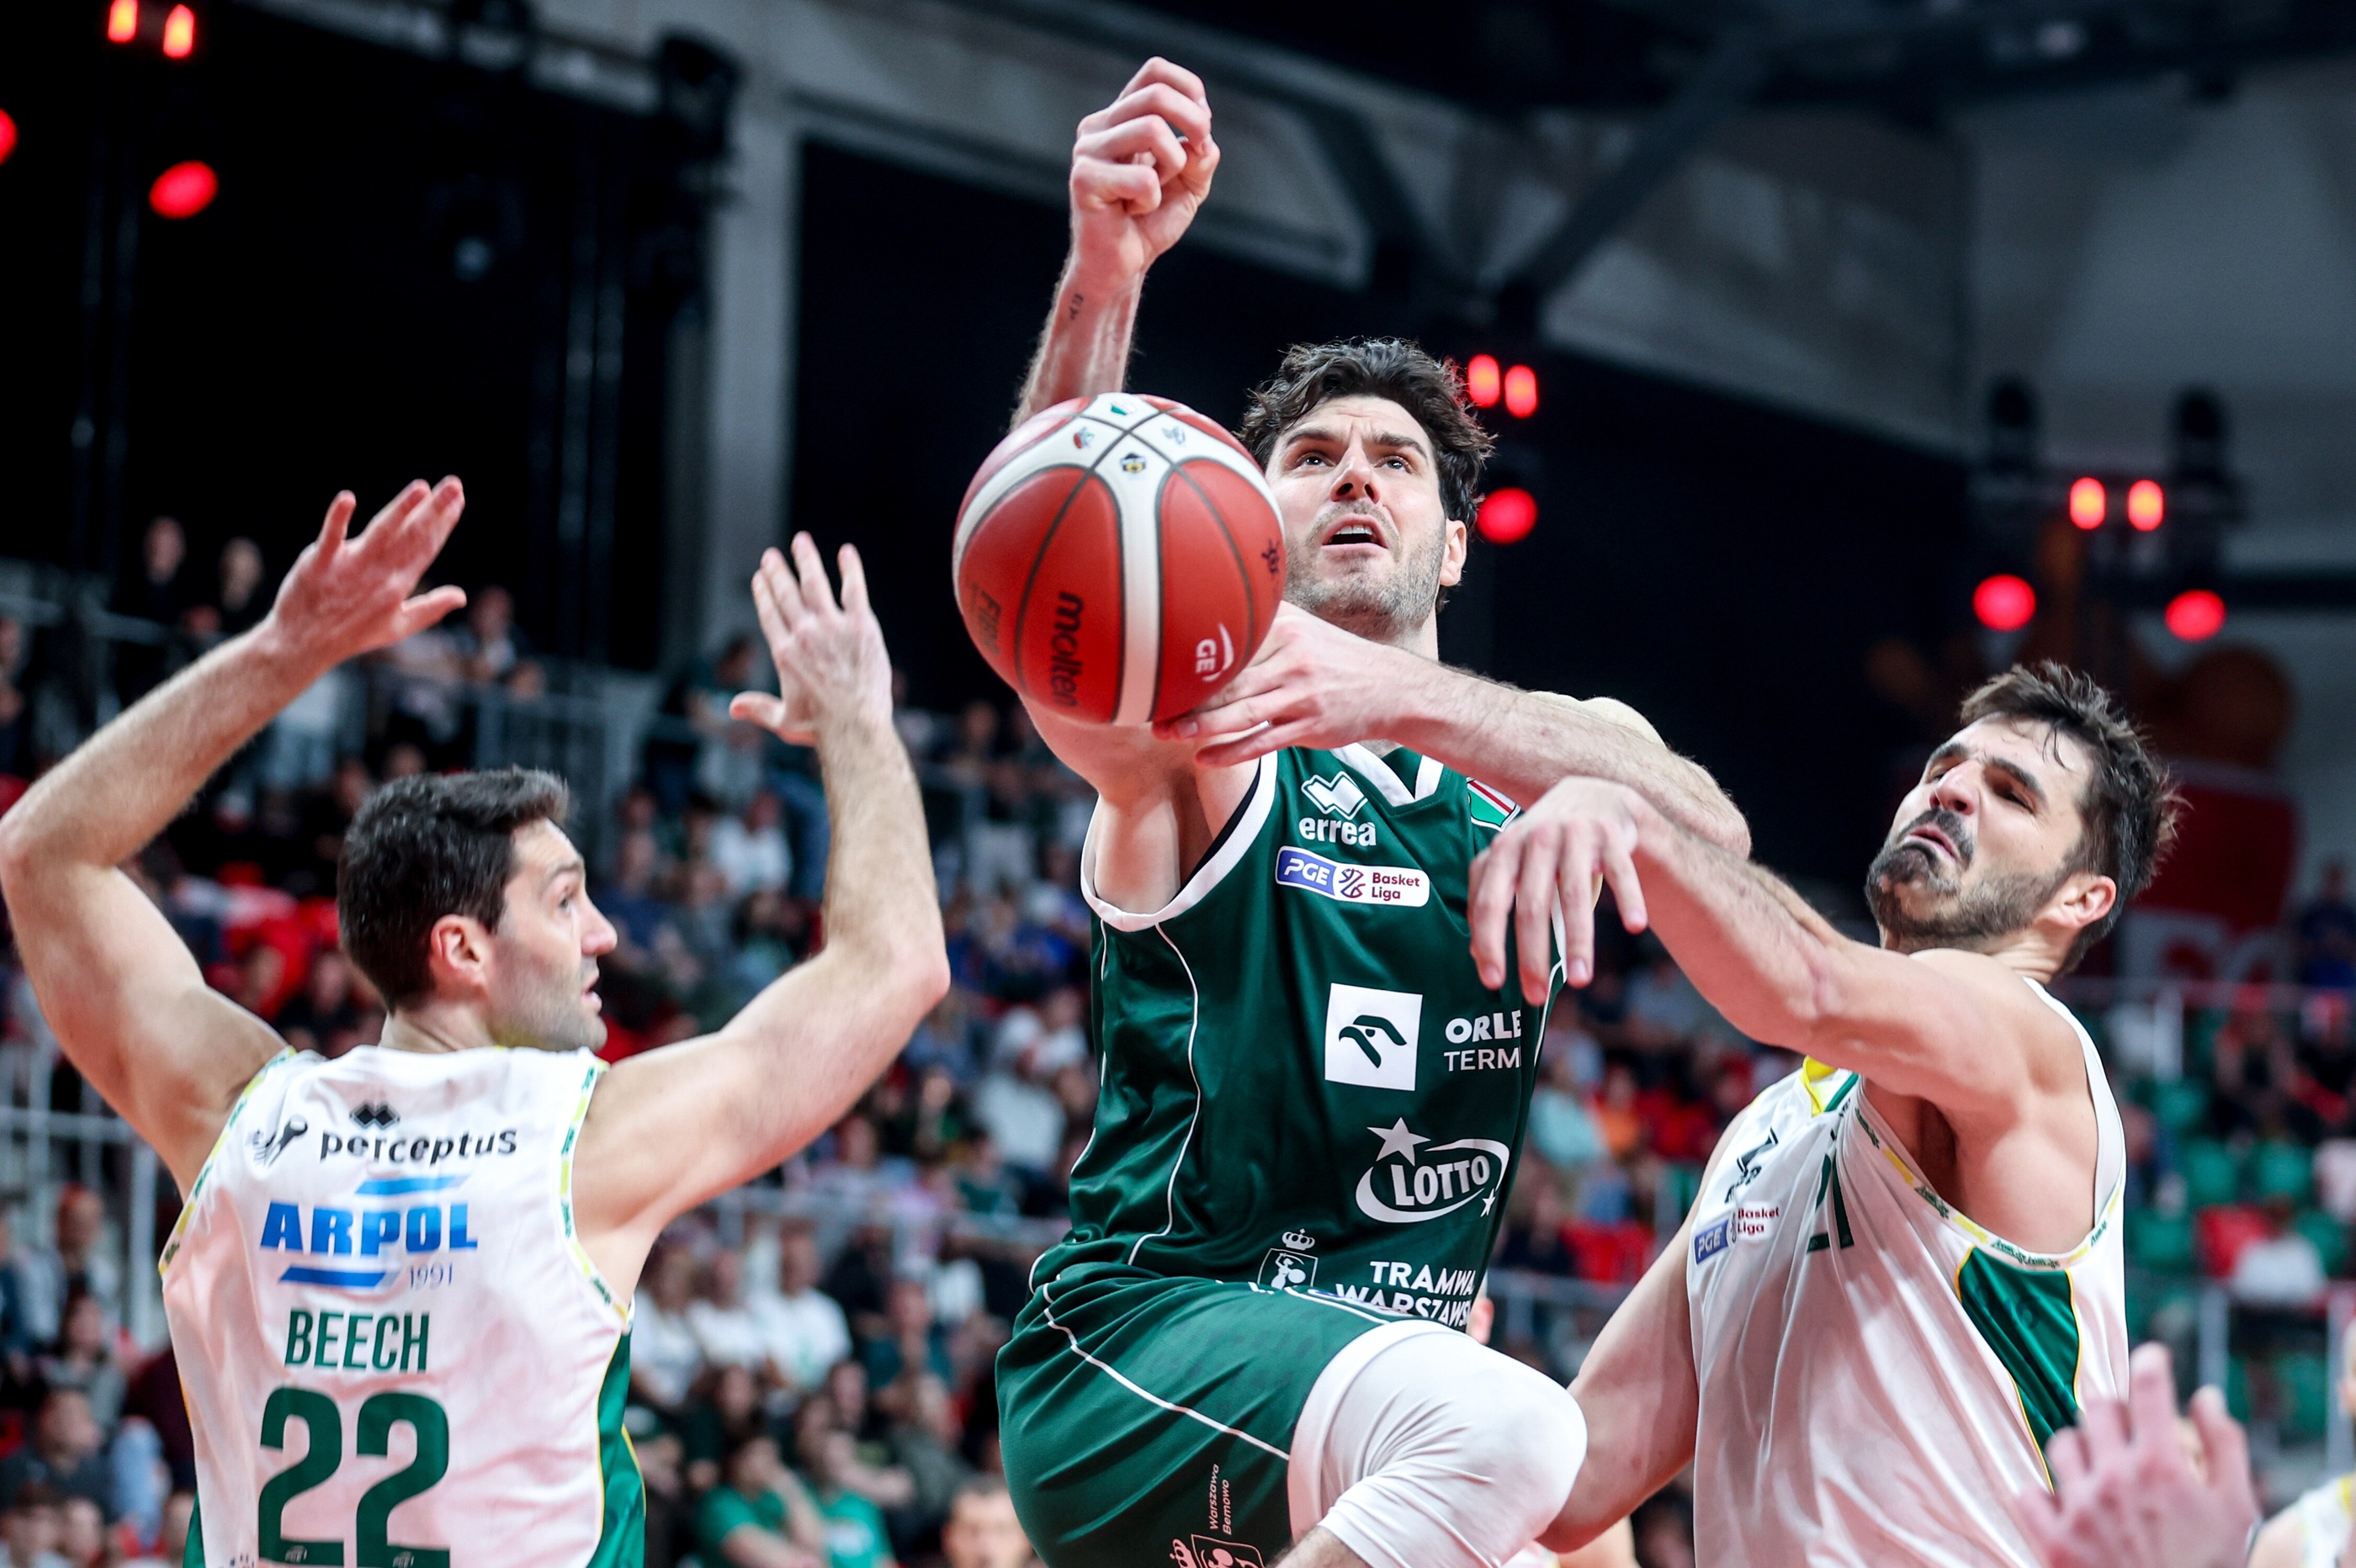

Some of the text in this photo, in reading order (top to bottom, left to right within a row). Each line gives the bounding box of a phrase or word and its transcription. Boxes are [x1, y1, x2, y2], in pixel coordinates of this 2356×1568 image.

[1051, 592, 1084, 707] molten
[1283, 857, 1331, 886] PGE
[1372, 871, 1420, 887] Basket
[1372, 886, 1401, 902] Liga
[1443, 1046, 1522, 1072] TERM
[320, 1128, 517, 1166] perceptus
[1390, 1155, 1490, 1206] LOTTO
[260, 1199, 478, 1256] ARPOL
[1737, 1221, 1764, 1236] Liga
[1738, 1206, 1780, 1220] Basket
[1697, 1225, 1723, 1259] PGE
[410, 1263, 453, 1290] 1991
[1370, 1261, 1477, 1295] TRAMWA
[1335, 1284, 1472, 1327] WARSZAWS
[284, 1309, 430, 1373] BEECH
[258, 1386, 451, 1568] 22
[1208, 1463, 1219, 1530] Warszawa
[1222, 1479, 1232, 1535] Bemowo
